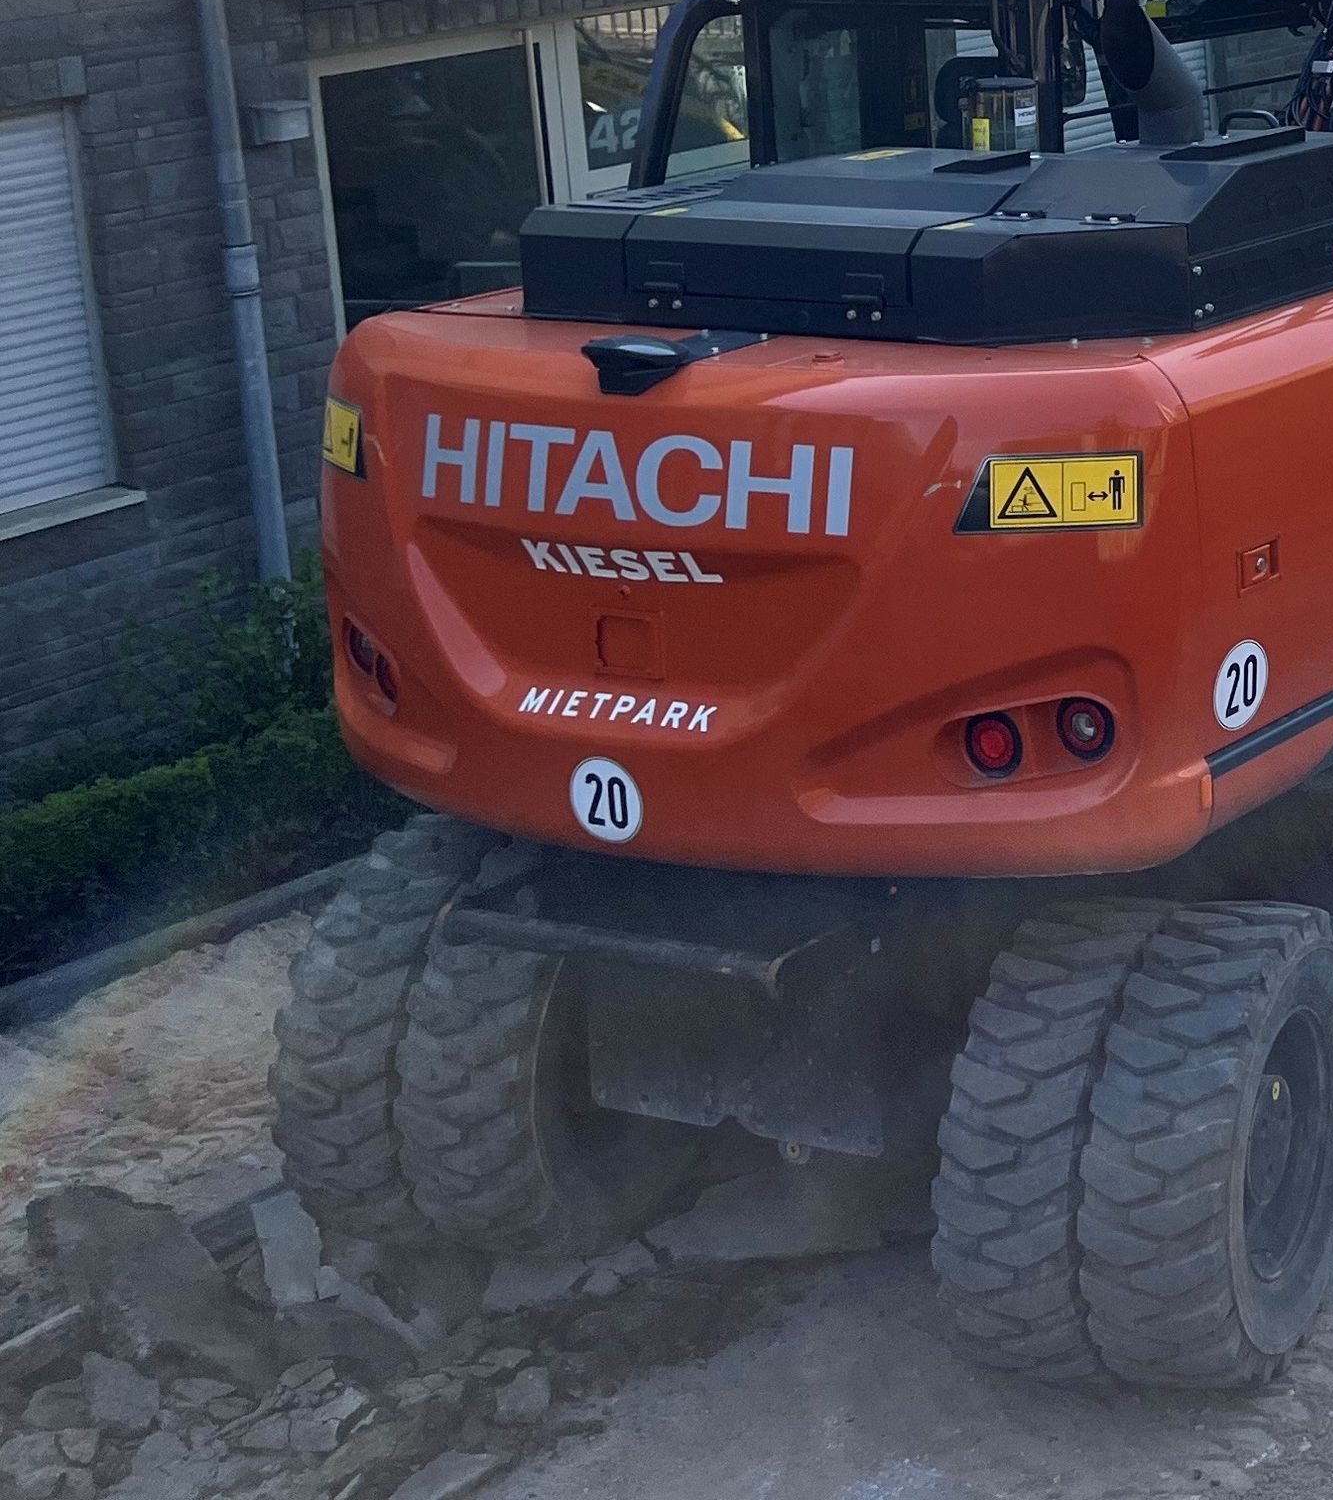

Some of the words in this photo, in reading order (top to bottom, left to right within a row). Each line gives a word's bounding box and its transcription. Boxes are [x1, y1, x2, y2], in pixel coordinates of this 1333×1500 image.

[421, 413, 855, 537] HITACHI
[522, 538, 724, 585] KIESEL
[518, 687, 719, 733] MIETPARK
[1225, 653, 1257, 719] 20
[584, 773, 629, 830] 20
